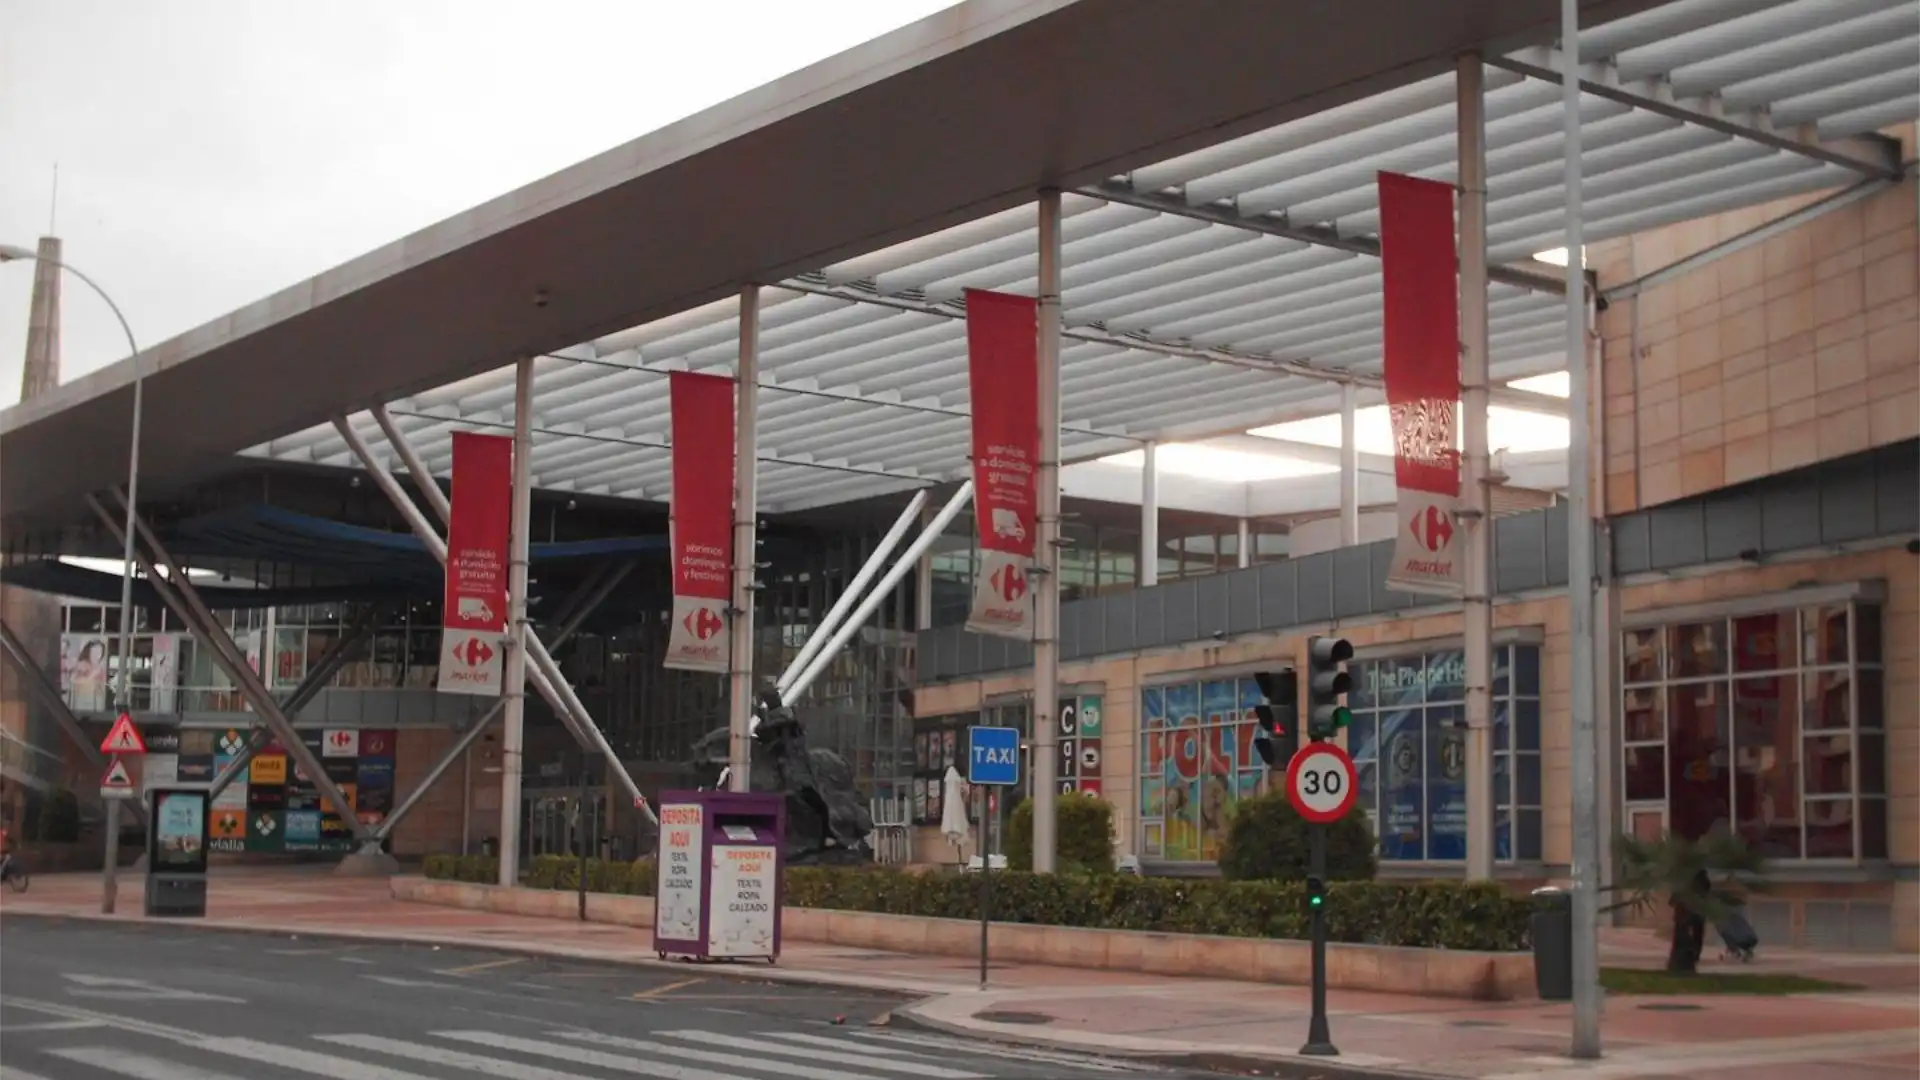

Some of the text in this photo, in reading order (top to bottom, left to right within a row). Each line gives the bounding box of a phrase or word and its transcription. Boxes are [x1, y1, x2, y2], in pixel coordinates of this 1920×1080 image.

[685, 544, 723, 556] abrimos
[682, 556, 726, 570] domingos
[1405, 557, 1452, 576] market
[690, 571, 725, 582] festivos
[682, 644, 720, 660] market
[451, 669, 489, 684] market
[1368, 669, 1397, 689] The
[1398, 665, 1444, 687] Phone
[973, 745, 1015, 765] TAXI
[1303, 770, 1341, 795] 30
[661, 807, 702, 825] DEPOSITA
[726, 850, 772, 860] DEPOSITA
[671, 864, 687, 875] ROPA
[665, 878, 693, 889] CALZADO
[737, 890, 760, 900] ROPA
[729, 903, 768, 912] CALZADO
